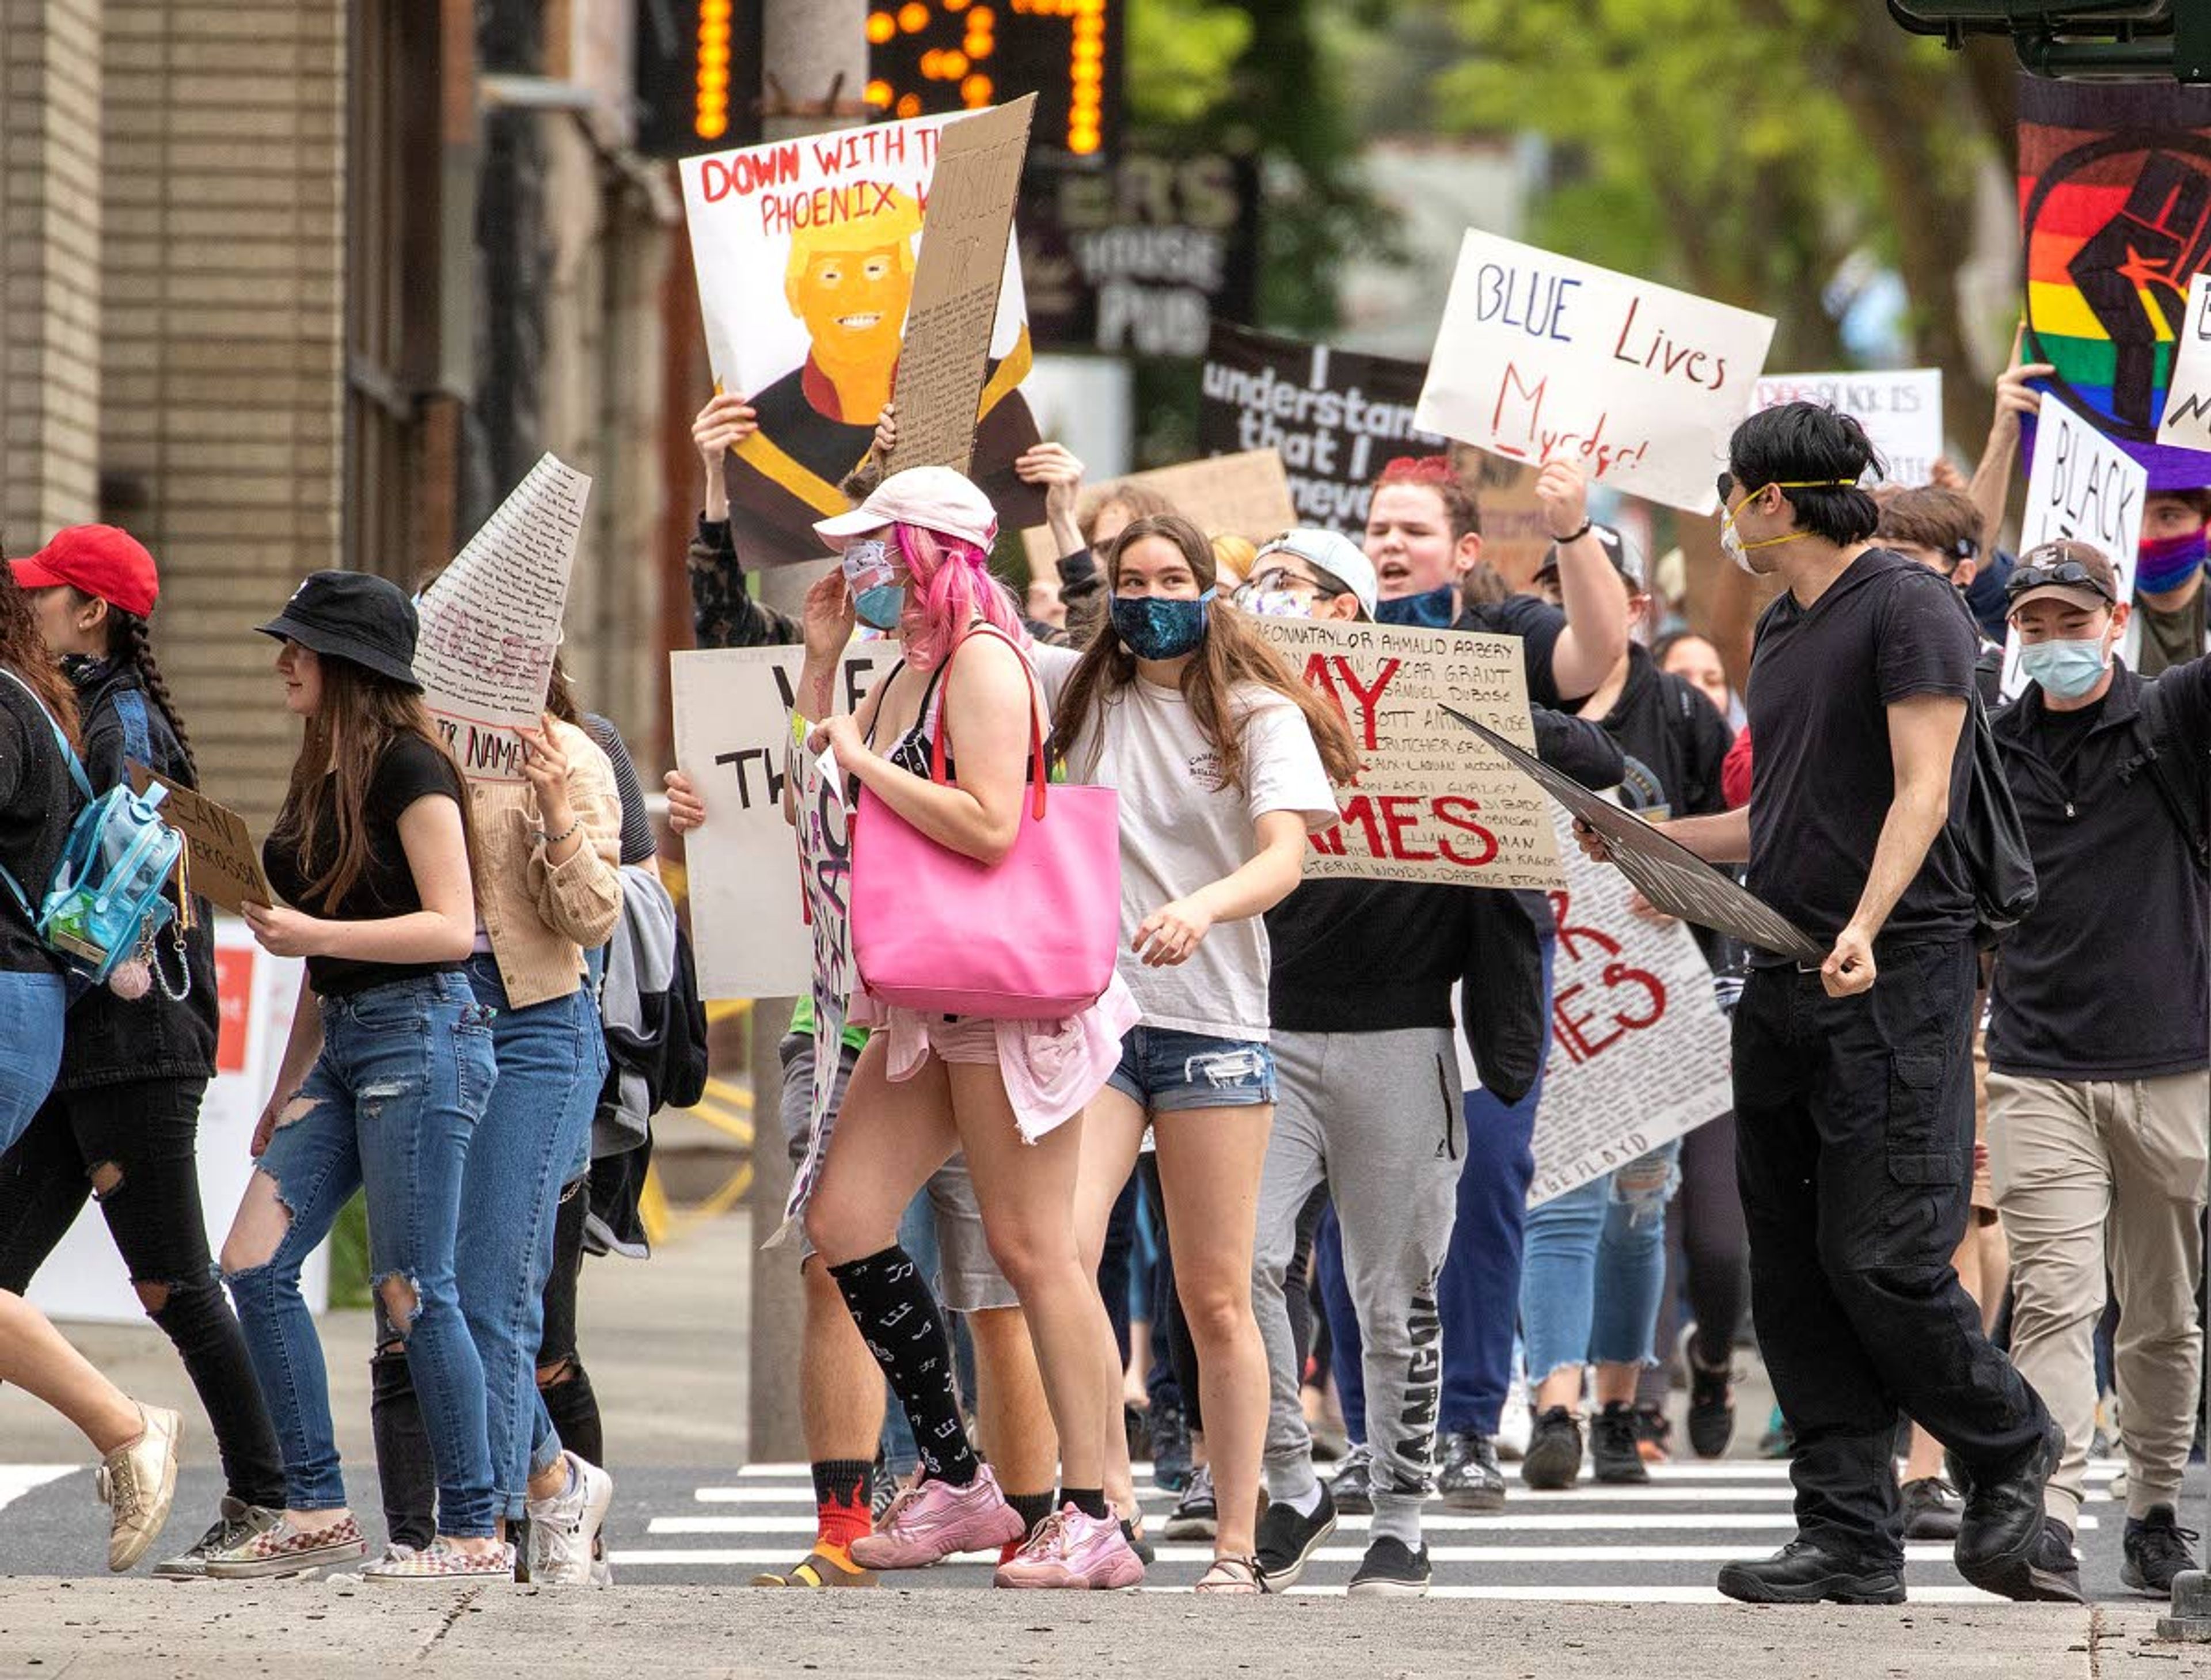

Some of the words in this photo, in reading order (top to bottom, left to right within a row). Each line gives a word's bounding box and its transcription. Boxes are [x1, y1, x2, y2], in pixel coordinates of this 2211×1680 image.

[701, 142, 799, 203] DOWN
[813, 126, 904, 176] WITH
[761, 179, 897, 236] PHOENIX
[1477, 263, 1582, 343] BLUE
[1614, 297, 1726, 390] Lives
[1309, 344, 1329, 390] I
[1201, 360, 1446, 447] understan
[1238, 408, 1339, 476] that
[1348, 434, 1372, 480] I
[2052, 419, 2135, 554] BLACK
[1445, 664, 1511, 684] GRANT
[1354, 707, 1415, 728] SOTT
